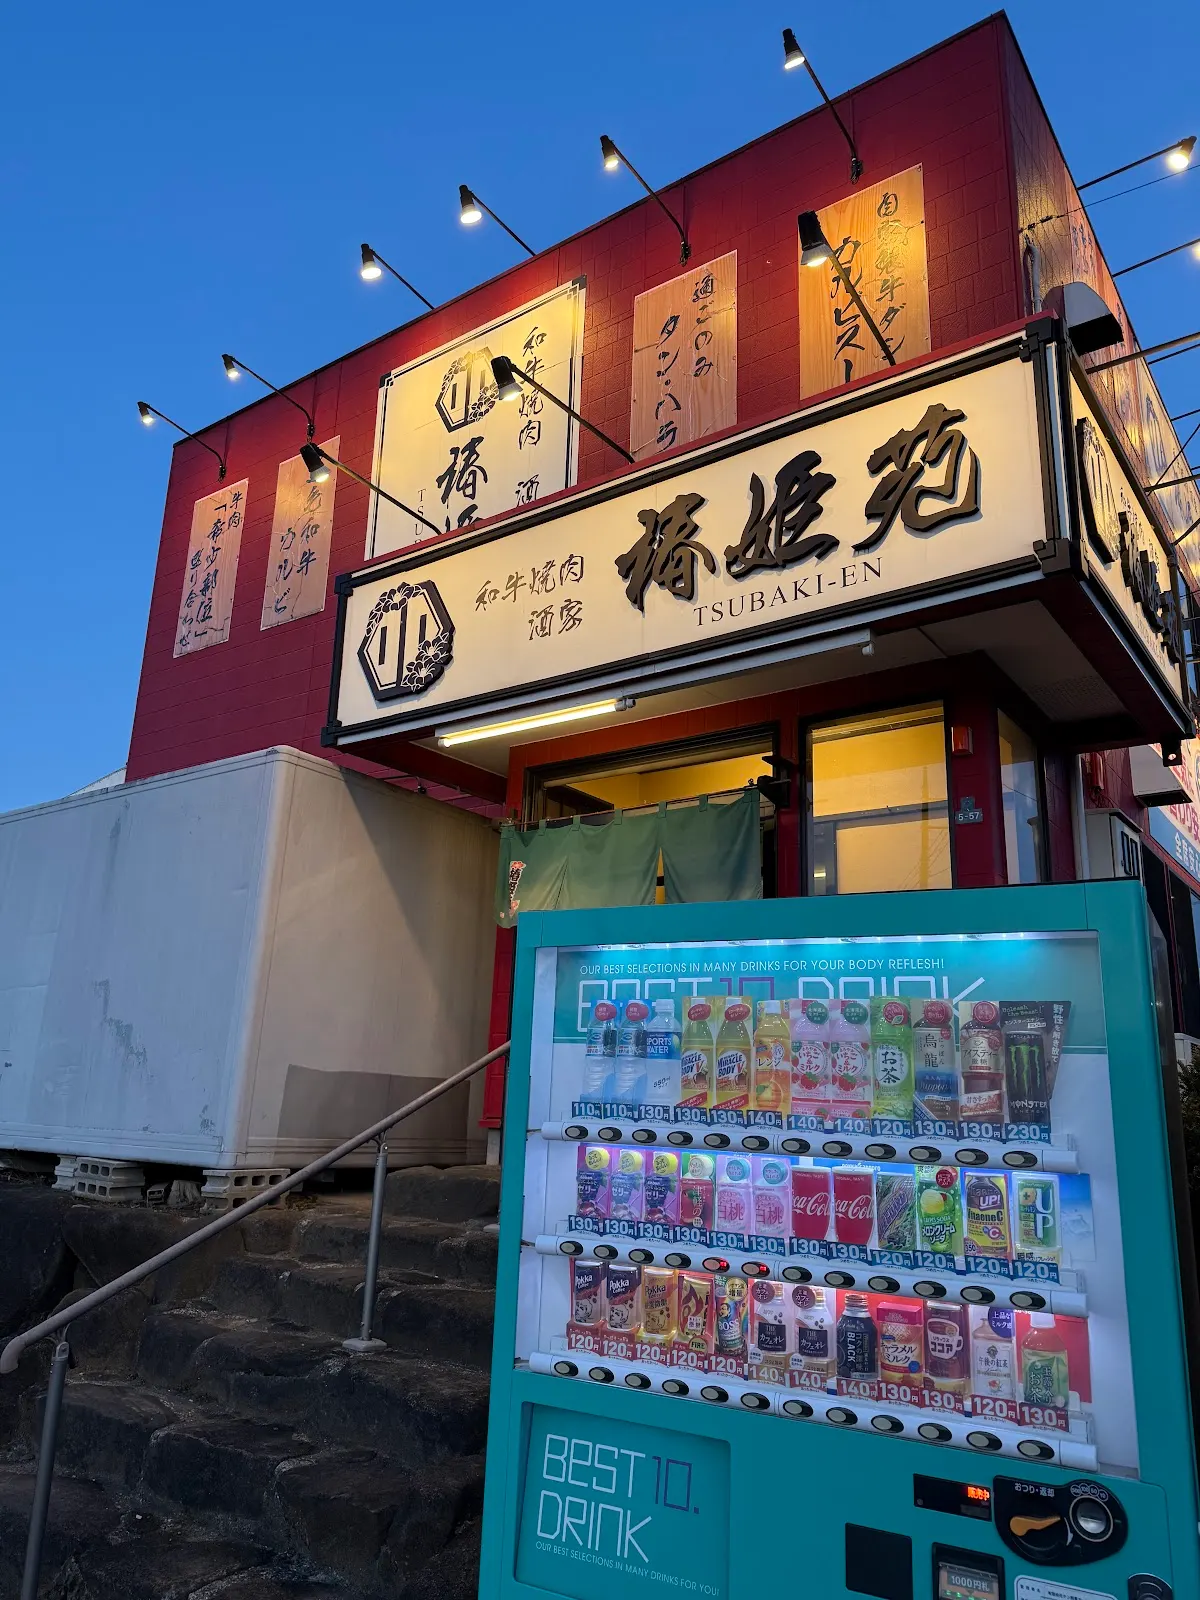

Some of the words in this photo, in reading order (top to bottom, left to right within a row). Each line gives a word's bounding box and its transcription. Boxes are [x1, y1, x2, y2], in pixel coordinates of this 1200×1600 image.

[227, 491, 244, 530] 牛肉
[414, 488, 427, 544] TSU
[296, 480, 322, 577] 毛和牛
[274, 527, 296, 614] カルビ
[692, 557, 884, 627] TSUBAKI-EN
[528, 598, 583, 642] 酒家
[958, 811, 980, 821] 5-57
[579, 965, 600, 975] OUR
[603, 964, 625, 974] BEST
[627, 962, 687, 974] SELECTIONS
[689, 962, 700, 973] IN
[703, 961, 737, 972] MANY
[740, 960, 781, 972] DRINKS
[783, 960, 807, 971] FOR
[810, 960, 845, 970] YOUR
[849, 959, 884, 970] BODY
[888, 958, 945, 970] REFLESH!
[798, 1051, 820, 1060] いちご
[836, 1051, 857, 1061] いちご
[923, 1033, 939, 1068] 烏龍
[962, 1048, 998, 1058] アイスティー
[717, 1053, 743, 1067] MIRACLE
[881, 1051, 901, 1084] お茶
[718, 1063, 735, 1077] BODY
[800, 1064, 820, 1073] ミルク
[837, 1065, 858, 1074] ミルク
[573, 1102, 601, 1116] 110円
[605, 1103, 632, 1118] 110円
[639, 1105, 669, 1120] 130円
[1009, 1099, 1048, 1110] MONSTER
[676, 1108, 706, 1121] 130円
[710, 1109, 744, 1124] 130円
[748, 1111, 782, 1126] 140円
[835, 1118, 871, 1135] 140円
[873, 1120, 911, 1136] 120円
[915, 1121, 954, 1136] 130円
[961, 1122, 1000, 1138] 130円
[1008, 1124, 1048, 1140] 230円
[577, 1185, 596, 1194] ゼリー
[611, 1187, 629, 1196] ゼリー
[645, 1190, 665, 1200] ゼリー
[979, 1194, 1001, 1207] UP!
[717, 1202, 744, 1221] 白桃
[755, 1206, 783, 1225] 白桃
[569, 1216, 598, 1231] 130円
[605, 1220, 634, 1236] 130円
[638, 1223, 668, 1239] 130円
[922, 1222, 957, 1237] メロンクリーム
[674, 1226, 706, 1243] 130円
[710, 1231, 744, 1249] 130円
[929, 1234, 946, 1244] ソーダ
[750, 1236, 784, 1253] 130円
[791, 1238, 827, 1256] 130円
[829, 1244, 867, 1260] 130円
[872, 1250, 911, 1266] 120円
[914, 1252, 954, 1269] 120円
[967, 1256, 1008, 1274] 120円
[1014, 1261, 1057, 1279] 120円
[609, 1279, 630, 1291] Pokka
[645, 1284, 666, 1297] Pokka
[992, 1310, 1011, 1320] 上品な
[570, 1333, 599, 1351] 120円
[691, 1341, 705, 1349] FIRE
[759, 1333, 785, 1345] カフェオレ
[800, 1338, 826, 1349] カフェオレ
[847, 1331, 856, 1363] BLACK
[603, 1340, 632, 1358] 120円
[636, 1343, 666, 1361] 120円
[880, 1342, 918, 1355] キャラメル
[930, 1342, 953, 1354] ココア
[671, 1349, 703, 1368] 120円
[709, 1356, 743, 1374] 120円
[885, 1352, 911, 1365] ミルク
[978, 1356, 1008, 1369] 午後の紅茶
[749, 1365, 785, 1382] 140円
[793, 1370, 828, 1388] 140円
[840, 1380, 877, 1397] 140円
[880, 1382, 918, 1403] 130円
[1029, 1373, 1043, 1403] お茶
[922, 1389, 963, 1410] 130円
[973, 1397, 1016, 1418] 120円
[1021, 1405, 1066, 1427] 130円
[542, 1433, 646, 1498] BEST
[1014, 1482, 1055, 1498] おつり・返却
[1081, 1485, 1090, 1493] 100
[536, 1489, 653, 1563] DRINK
[535, 1540, 552, 1552] OUR
[553, 1545, 569, 1558] BEST
[570, 1549, 614, 1569] SELECTIONS
[615, 1560, 623, 1571] IN
[625, 1563, 650, 1578] MANY
[650, 1570, 679, 1586] DRINKS
[680, 1578, 697, 1591] FOR
[951, 1575, 990, 1592] 1000円札
